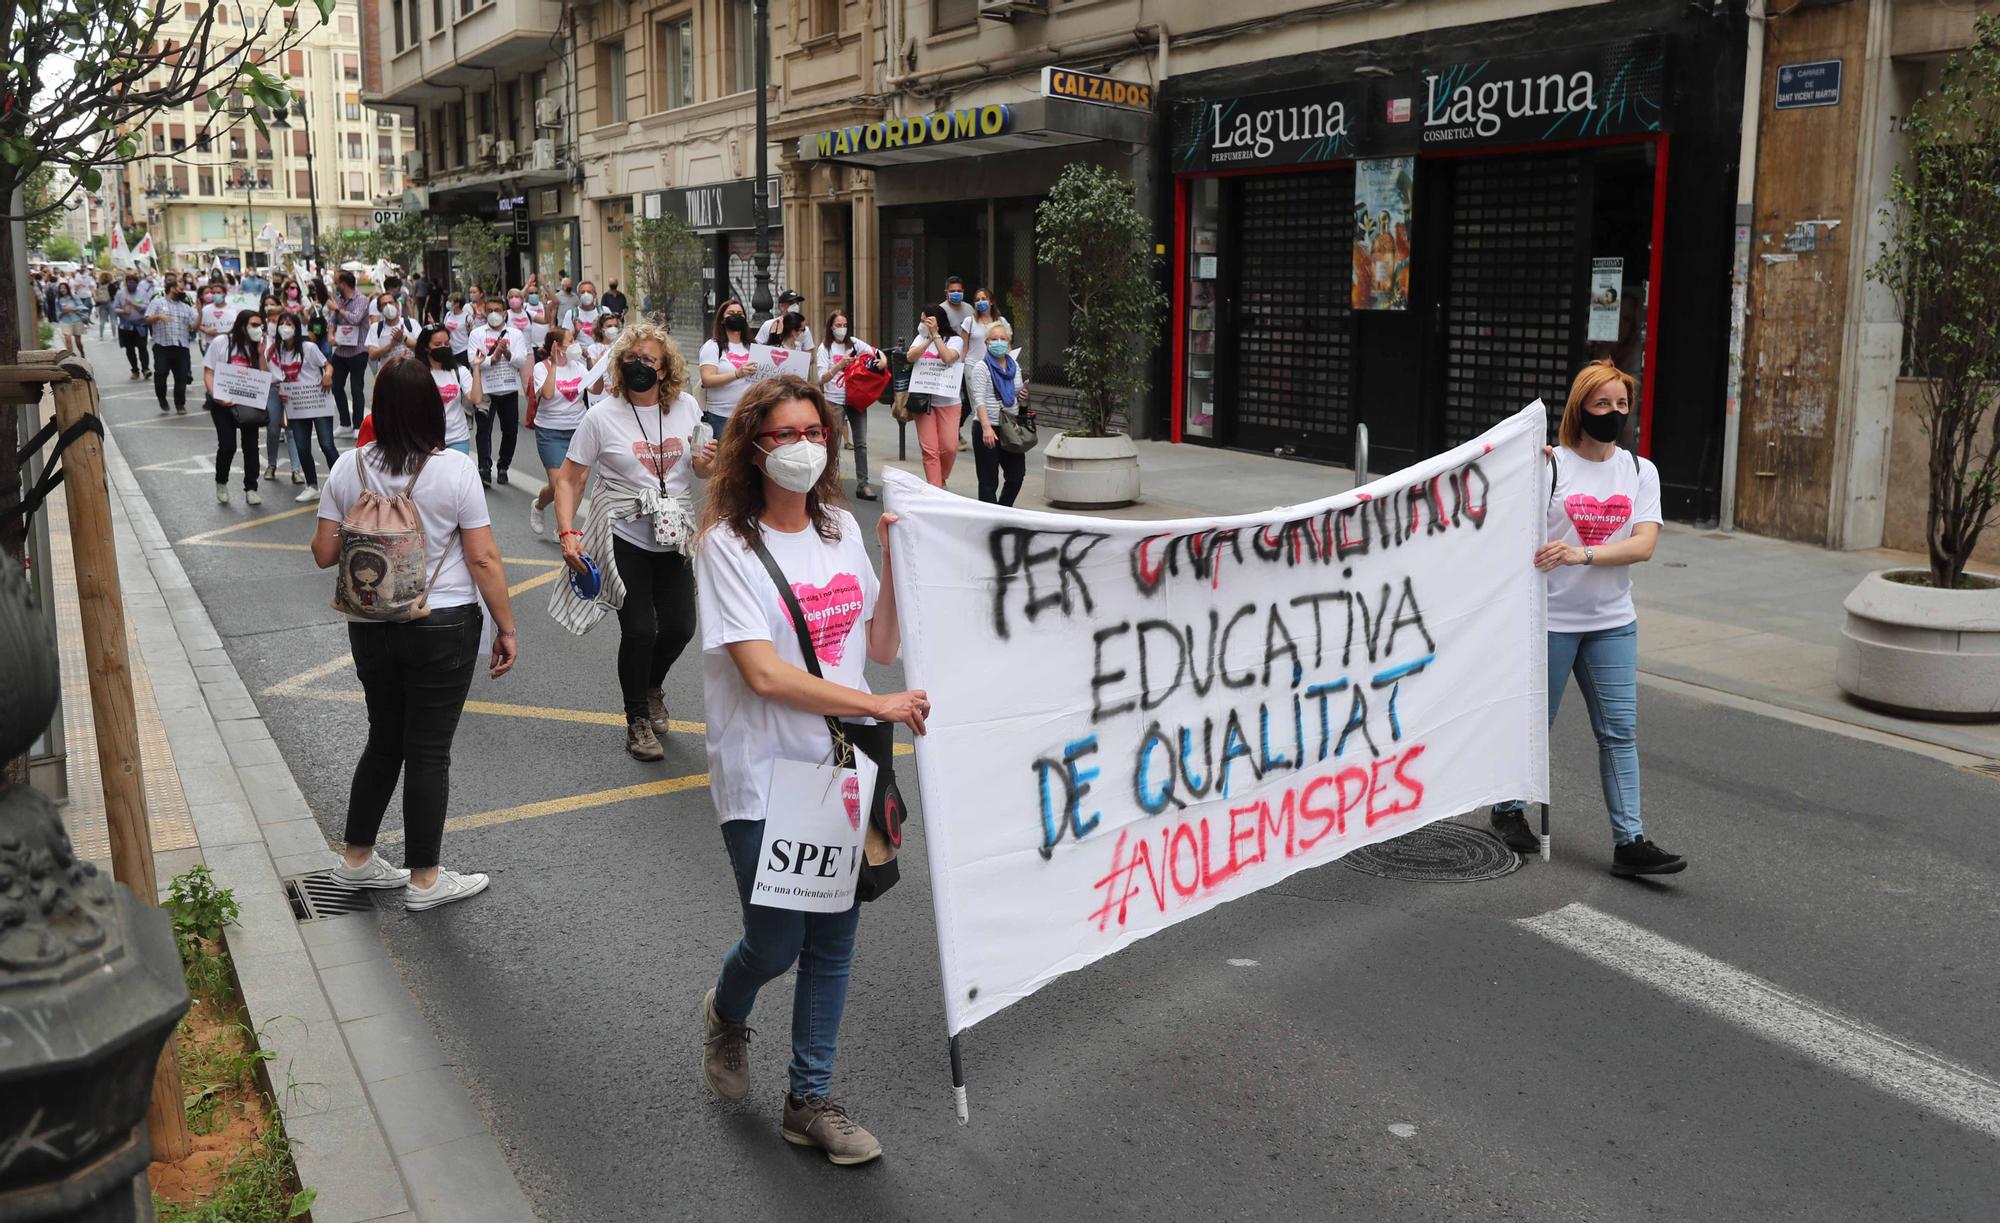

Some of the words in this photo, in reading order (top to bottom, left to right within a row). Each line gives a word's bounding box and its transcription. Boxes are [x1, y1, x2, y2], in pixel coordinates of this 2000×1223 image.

[1053, 72, 1149, 106] CALZADOS
[1797, 68, 1825, 77] CARRER
[1424, 70, 1598, 136] Laguna
[1778, 94, 1793, 103] SANT
[1794, 91, 1814, 100] VICENT
[816, 103, 1005, 157] MAYORDOMO
[1211, 101, 1346, 158] Laguna
[1423, 127, 1475, 142] COSMETICA
[1211, 150, 1254, 162] PERFUMERIA
[1573, 512, 1627, 524] #volemspes
[989, 526, 1111, 640] PER
[1032, 734, 1101, 861] DE
[1133, 654, 1436, 815] QUALITAT
[1088, 744, 1426, 932] #VOLEMSPES
[767, 838, 842, 878] SPE
[756, 881, 773, 893] Per
[774, 886, 791, 895] una
[793, 887, 833, 899] Orientació
